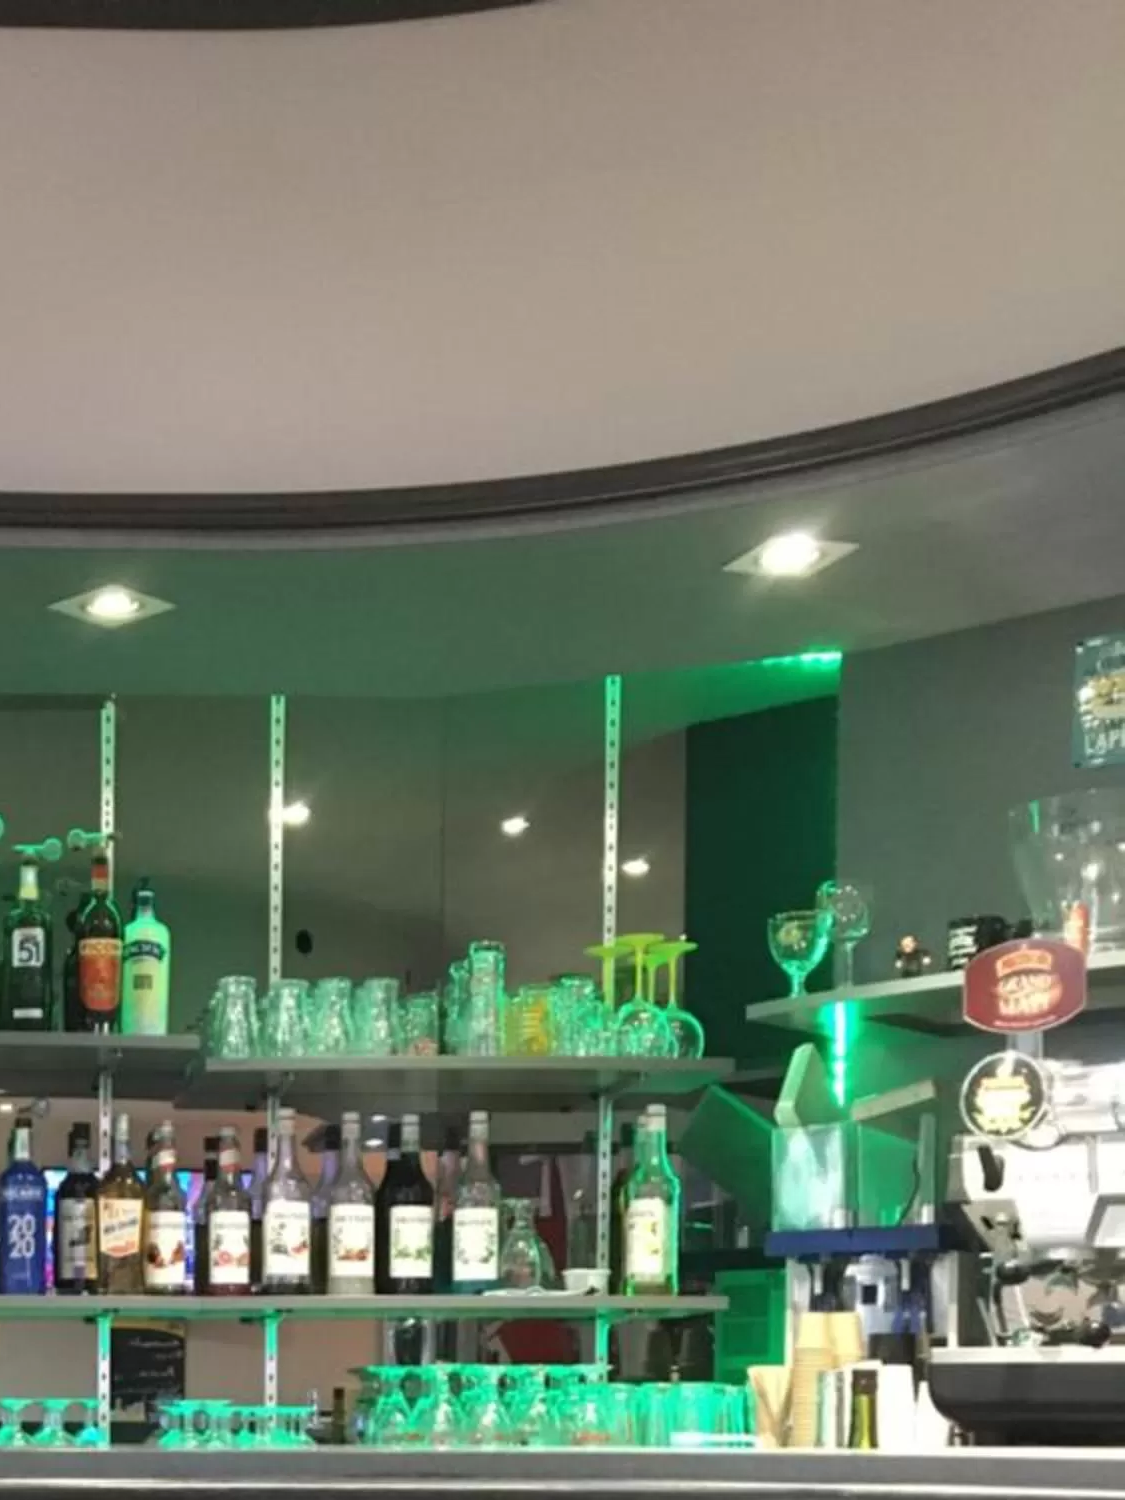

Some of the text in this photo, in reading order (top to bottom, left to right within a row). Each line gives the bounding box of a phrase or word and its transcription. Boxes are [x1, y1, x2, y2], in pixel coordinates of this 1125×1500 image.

[18, 937, 41, 963] 51
[7, 1214, 36, 1235] 20
[7, 1235, 36, 1258] 20
